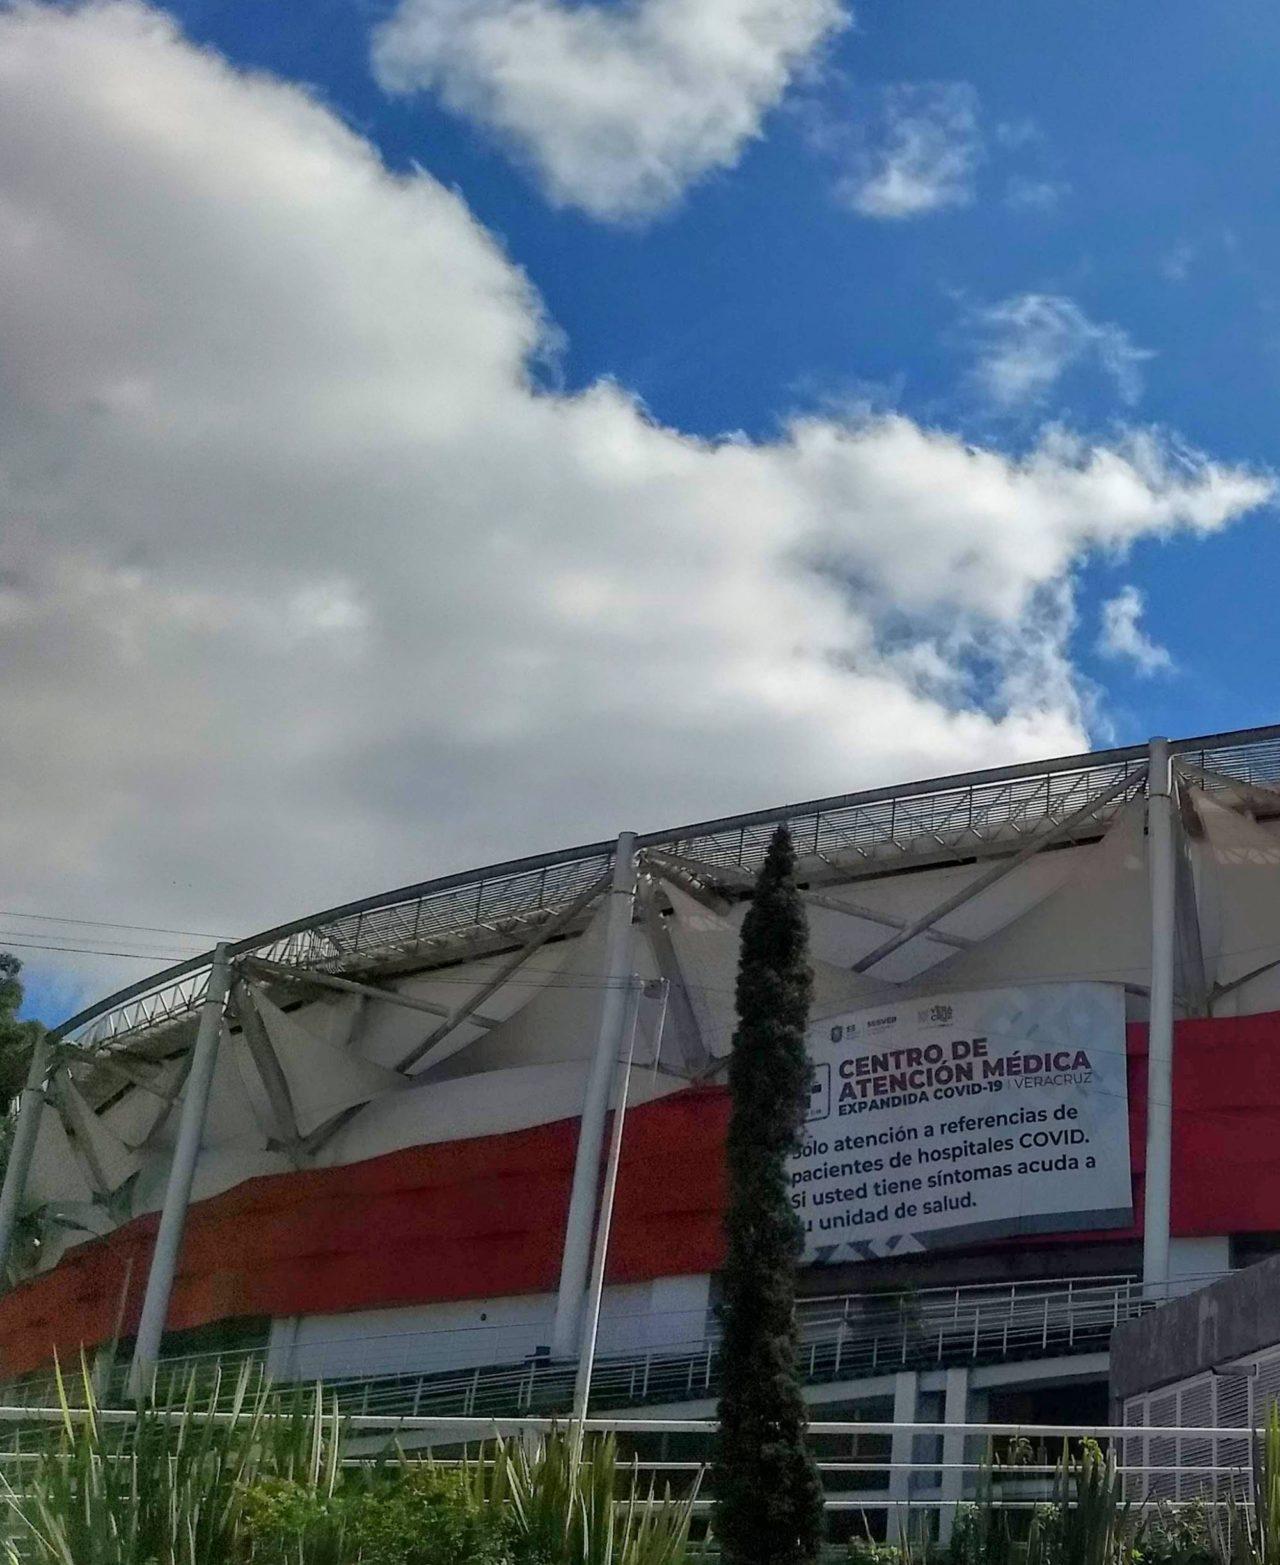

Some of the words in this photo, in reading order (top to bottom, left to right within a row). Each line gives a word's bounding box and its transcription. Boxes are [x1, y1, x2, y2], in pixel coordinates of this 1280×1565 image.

[839, 1044, 943, 1079] CENTRO
[952, 1037, 988, 1060] DE
[839, 1059, 974, 1102] ATENCIÓN
[982, 1050, 1091, 1079] MÉDICA
[838, 1091, 929, 1116] EXPANDIDA
[933, 1080, 1003, 1100] COVID-19
[1014, 1072, 1093, 1089] VERACRUZ
[834, 1125, 918, 1152] atención
[924, 1125, 934, 1137] a
[940, 1107, 1047, 1134] referencias
[1053, 1104, 1078, 1120] de
[791, 1159, 883, 1188] pacientes
[889, 1152, 912, 1168] de
[918, 1138, 1014, 1163] hospitales
[1019, 1129, 1090, 1148] COVID.
[791, 1190, 806, 1209] Si
[812, 1183, 867, 1206] usted
[873, 1178, 921, 1197] tiene
[927, 1163, 1012, 1188] síntomas
[1018, 1154, 1079, 1174] acuda
[1085, 1156, 1096, 1169] a
[820, 1205, 888, 1230] unidad
[894, 1202, 917, 1218] de
[923, 1191, 977, 1215] salud.
